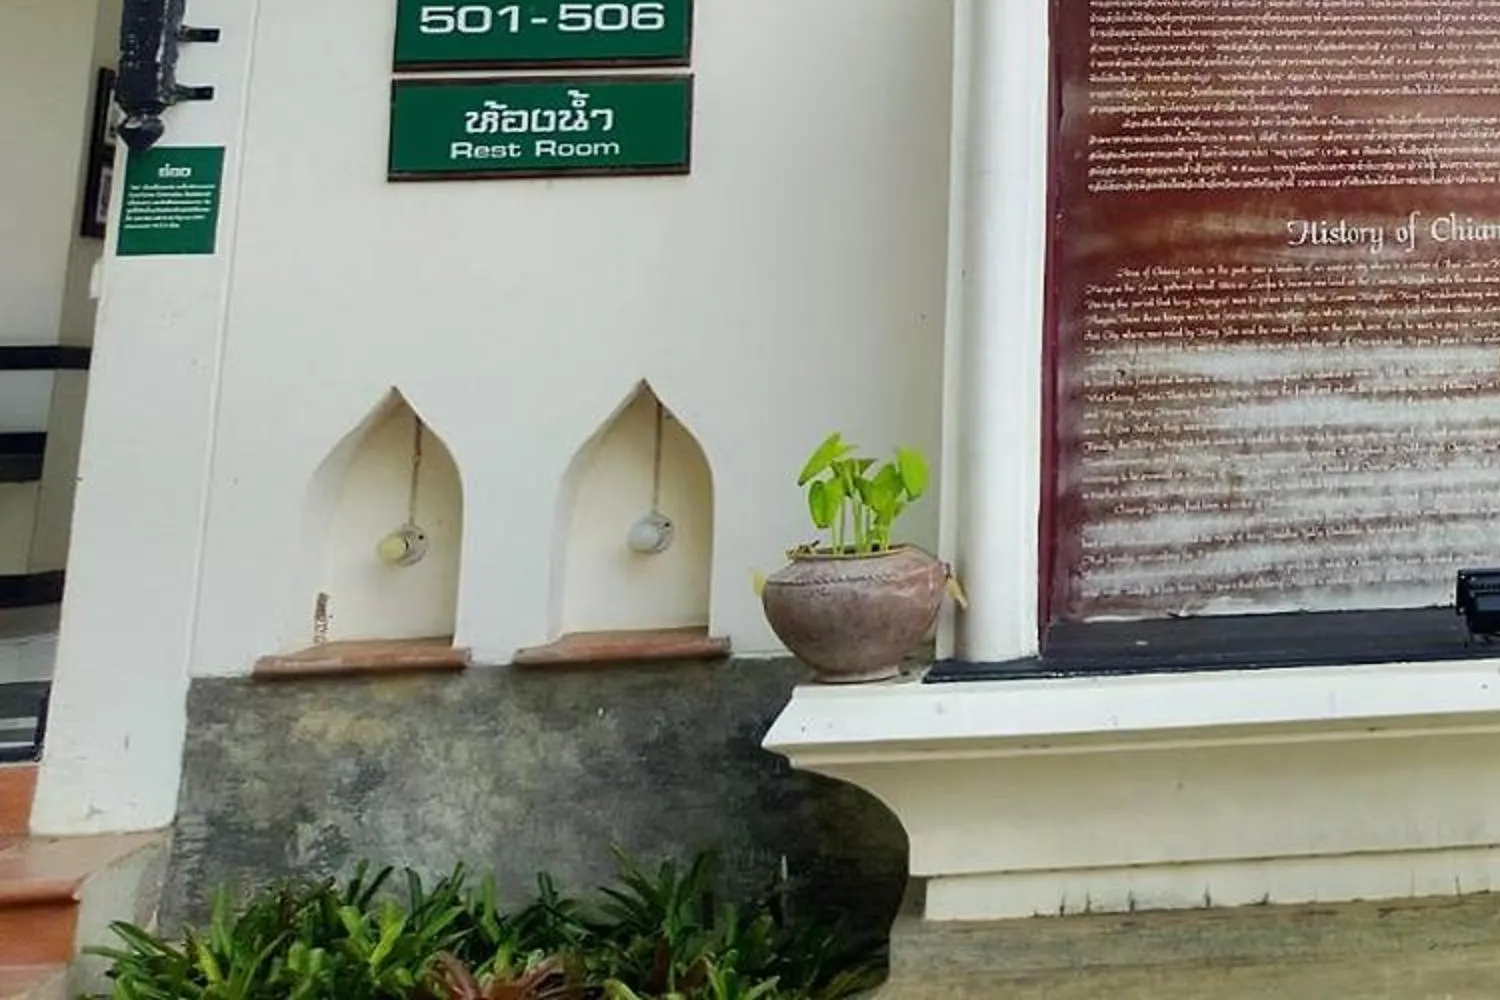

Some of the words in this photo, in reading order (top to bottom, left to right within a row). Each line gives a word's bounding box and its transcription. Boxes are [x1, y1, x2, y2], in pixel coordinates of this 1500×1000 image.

[465, 90, 613, 134] ห้องน้ำ
[450, 142, 520, 159] Rest
[535, 140, 620, 157] Room
[1287, 219, 1383, 254] History
[1395, 211, 1420, 252] of
